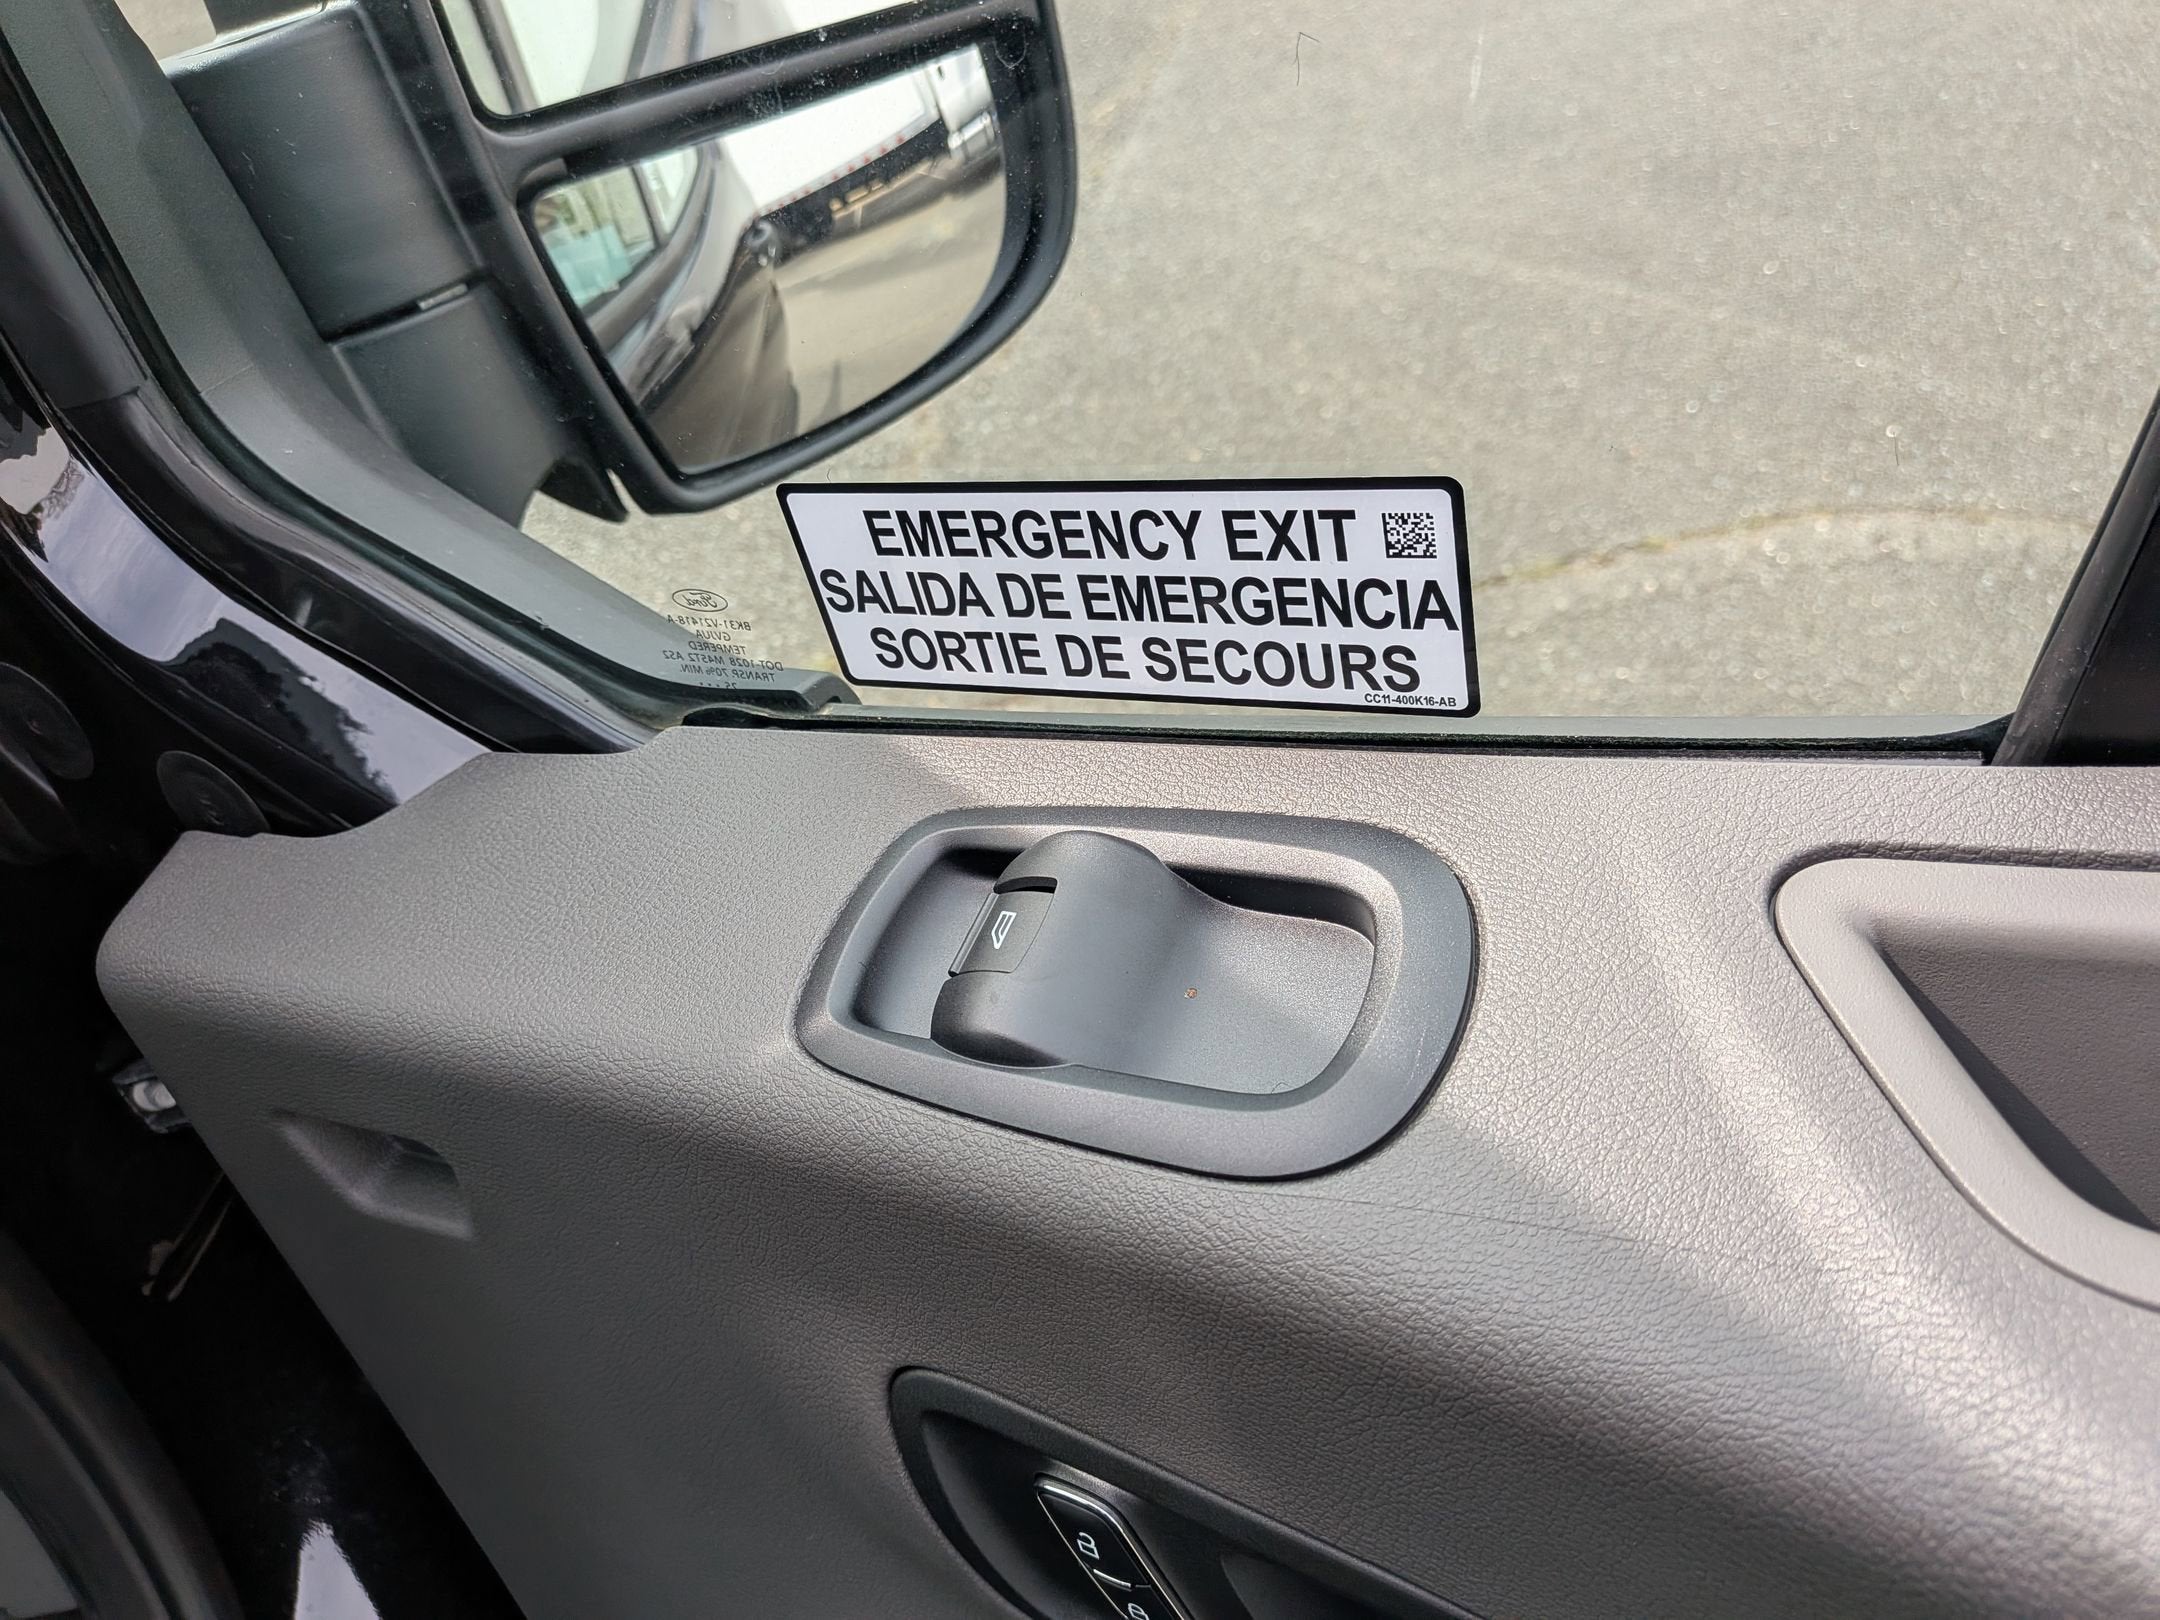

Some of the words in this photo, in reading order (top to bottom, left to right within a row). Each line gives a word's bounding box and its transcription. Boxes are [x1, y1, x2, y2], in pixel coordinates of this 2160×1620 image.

[863, 509, 1201, 561] EMERGENCY
[1222, 509, 1356, 562] EXIT
[820, 568, 995, 618] SALIDA
[996, 572, 1071, 620] DE
[1077, 574, 1460, 631] EMERGENCIA
[870, 627, 1048, 676] SORTIE
[1055, 634, 1131, 680] DE
[1141, 636, 1421, 693] SECOURS
[1364, 693, 1457, 707] CC11-400K16-AB
